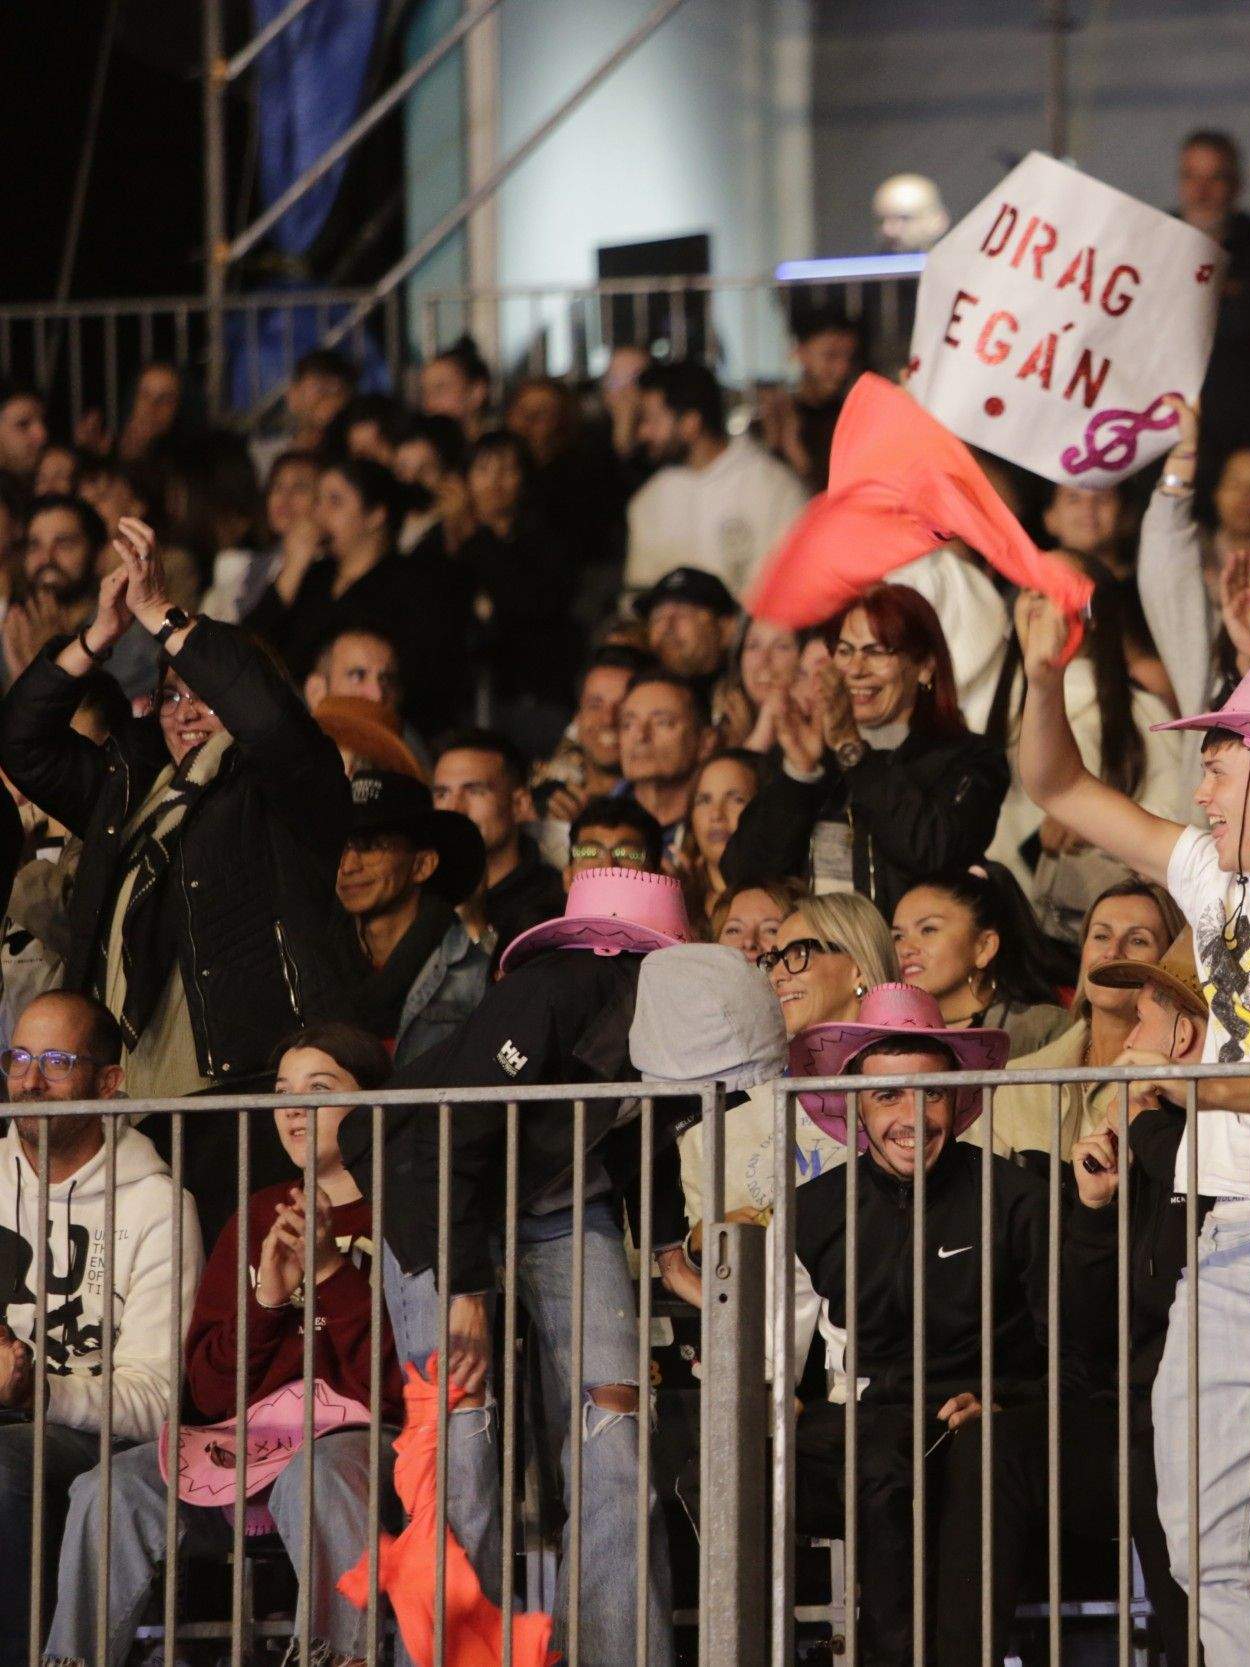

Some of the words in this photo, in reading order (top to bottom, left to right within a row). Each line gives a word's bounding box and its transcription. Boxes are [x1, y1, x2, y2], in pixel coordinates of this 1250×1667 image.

[981, 202, 1140, 317] DRAG
[944, 289, 1111, 409] EGÁN
[95, 1228, 128, 1241] UIL
